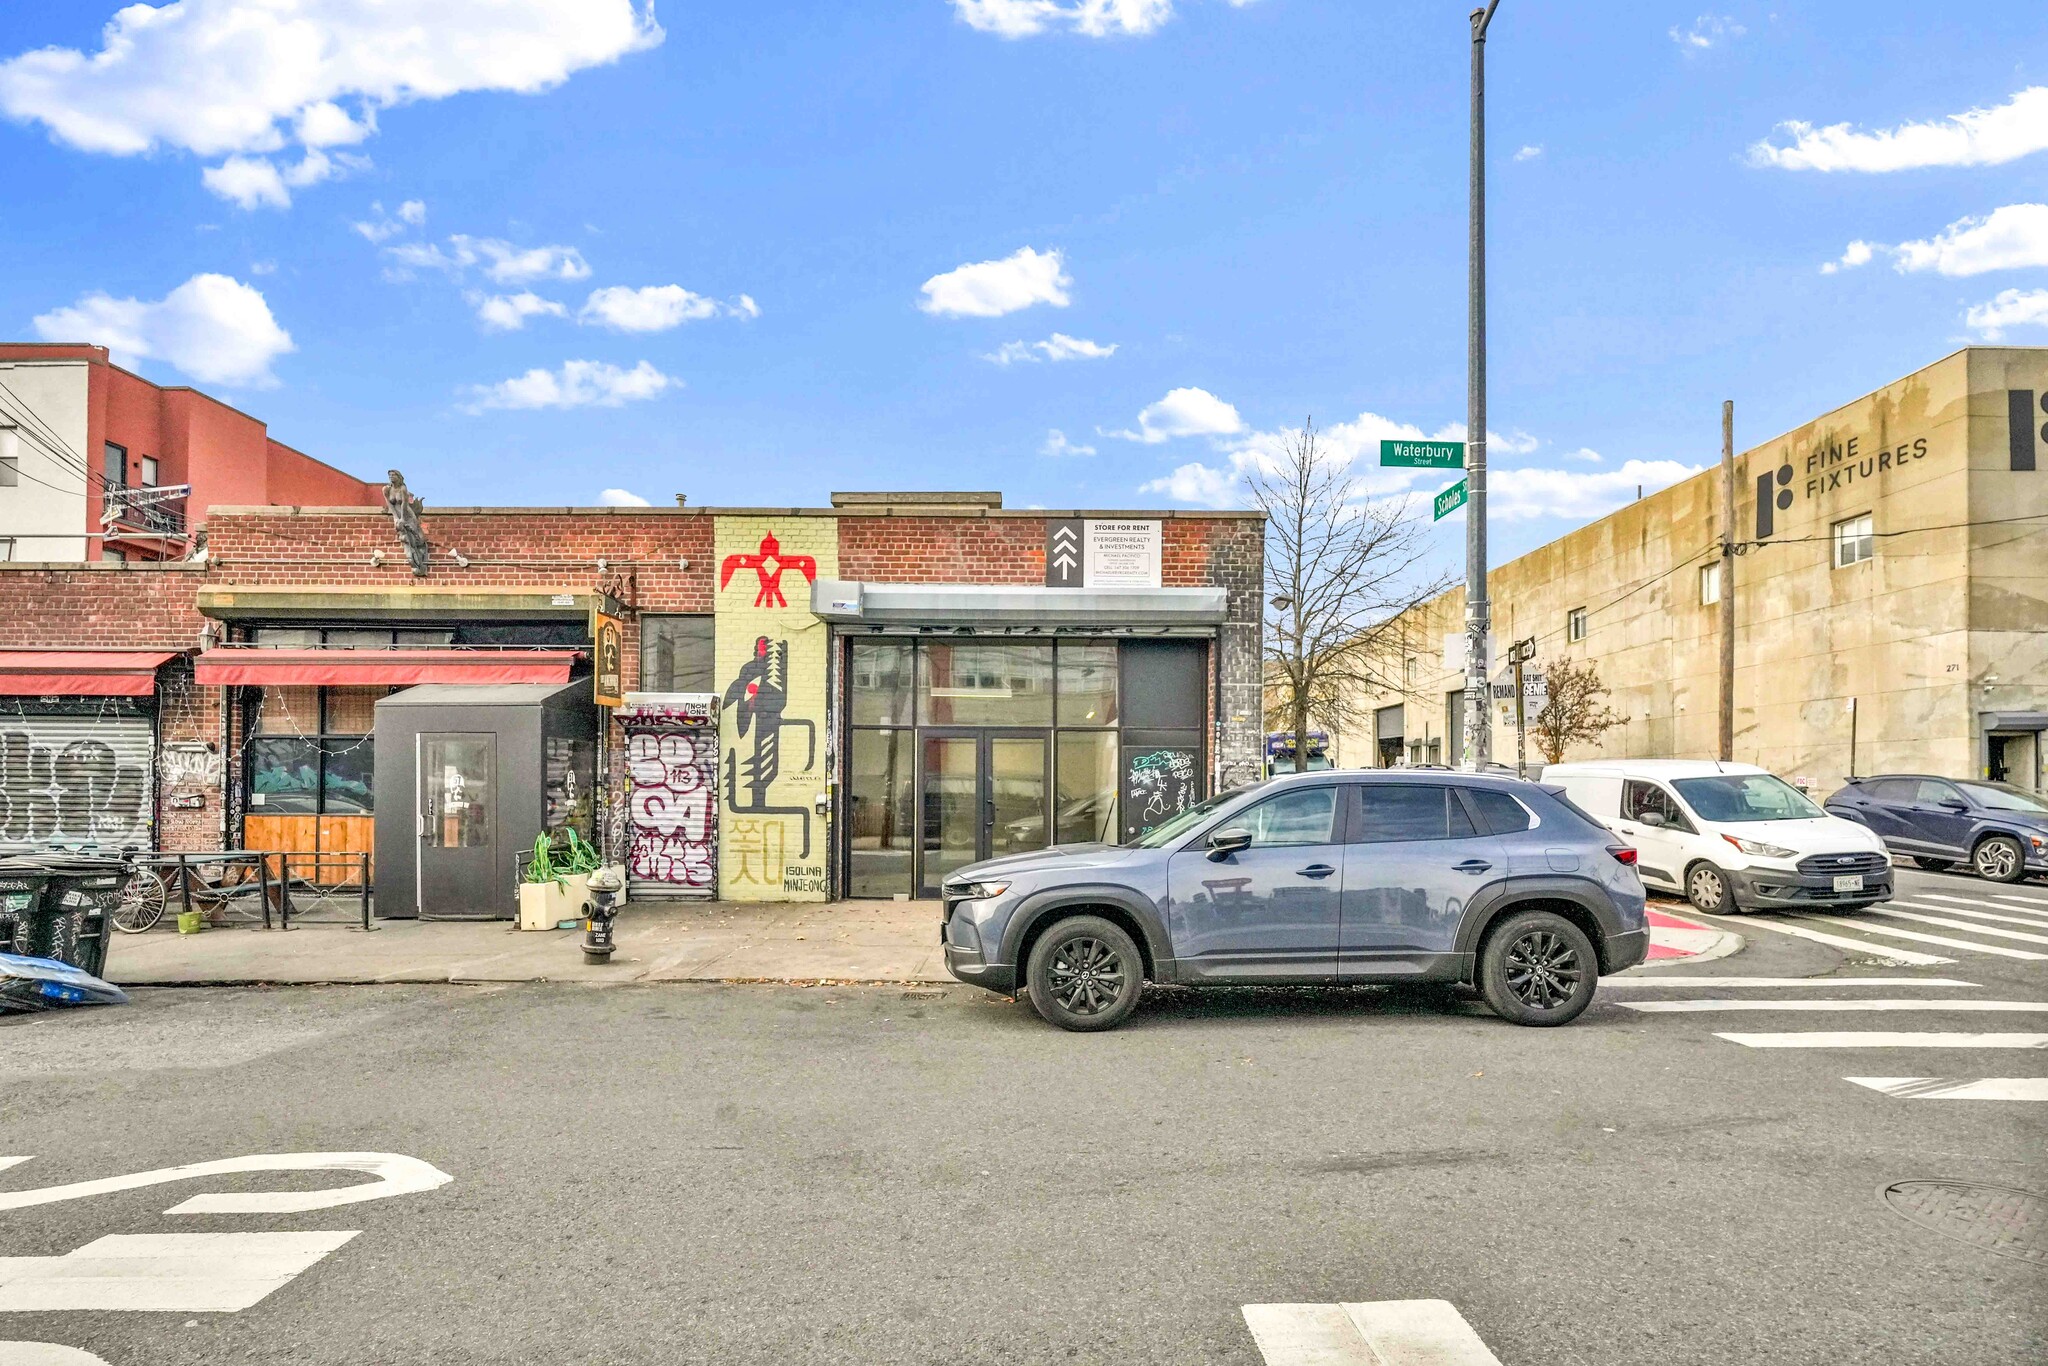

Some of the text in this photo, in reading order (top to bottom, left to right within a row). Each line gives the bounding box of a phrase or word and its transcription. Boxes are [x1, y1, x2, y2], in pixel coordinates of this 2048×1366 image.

[1393, 443, 1453, 461] Waterbury
[1807, 437, 1859, 474] FINE
[1413, 457, 1432, 465] Street
[1807, 438, 1928, 499] FIXTURES
[1438, 490, 1461, 516] Scholes
[1946, 664, 1959, 672] 271
[1493, 684, 1515, 699] REMAND
[1523, 683, 1547, 696] GENIE
[786, 866, 822, 877] ISOLINA
[783, 879, 826, 892] MINJEONG
